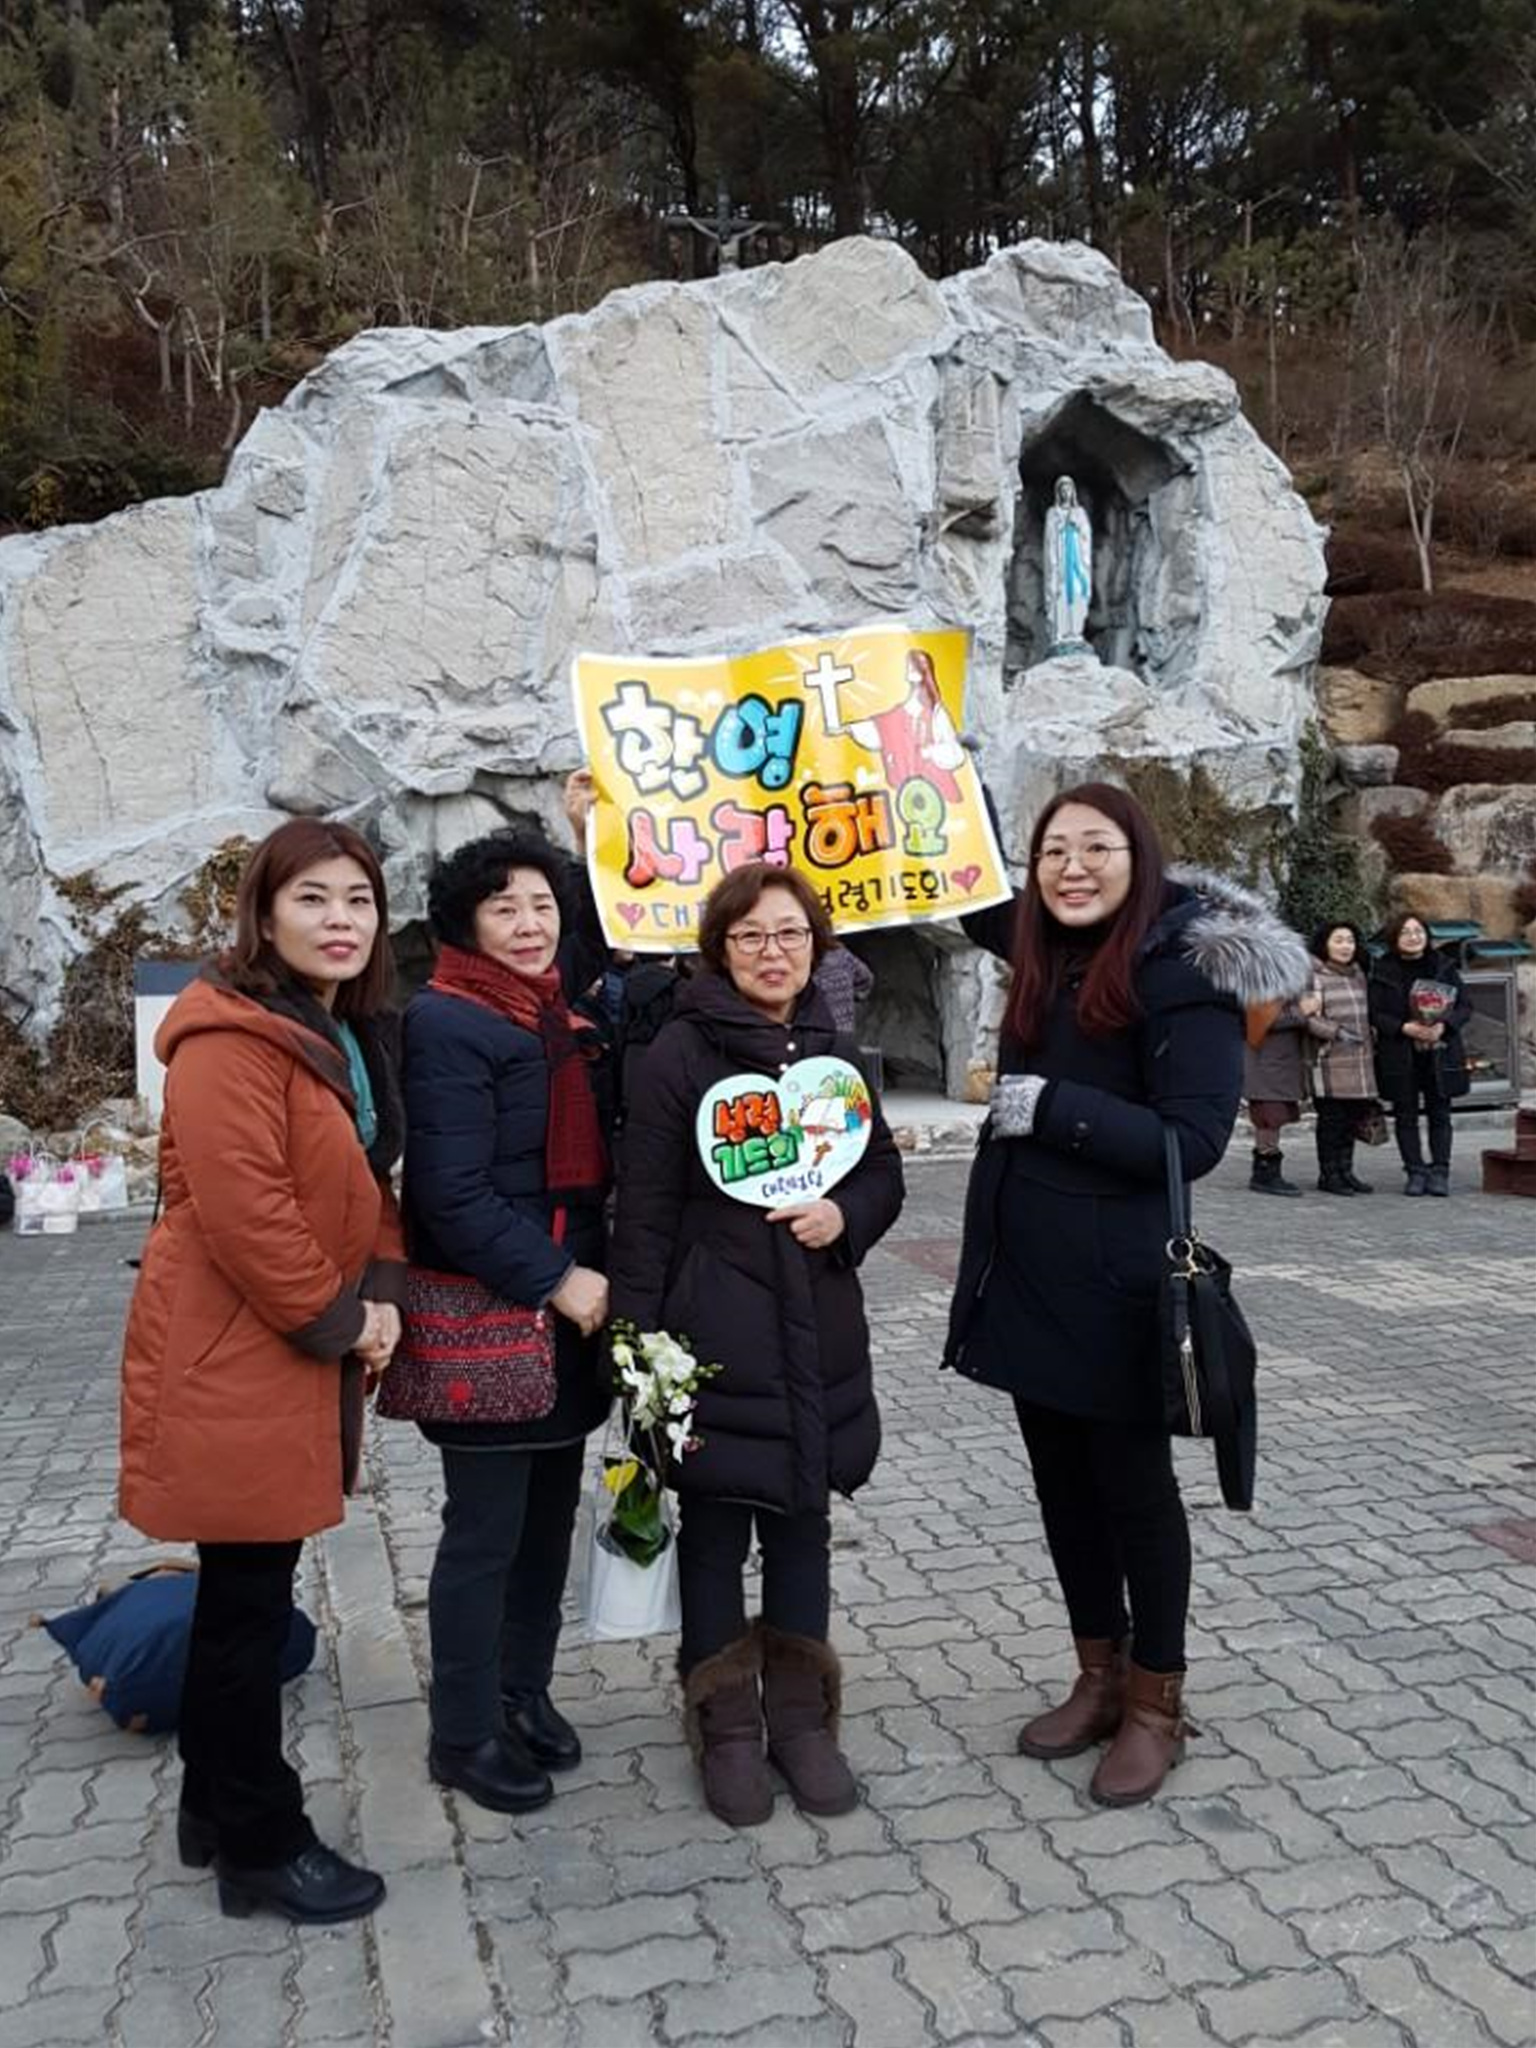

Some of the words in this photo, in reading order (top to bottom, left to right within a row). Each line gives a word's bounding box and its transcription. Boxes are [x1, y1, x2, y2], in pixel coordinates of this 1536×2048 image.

[600, 681, 804, 801] 환영
[713, 1089, 783, 1143] 성령
[711, 1131, 799, 1184] 기도회
